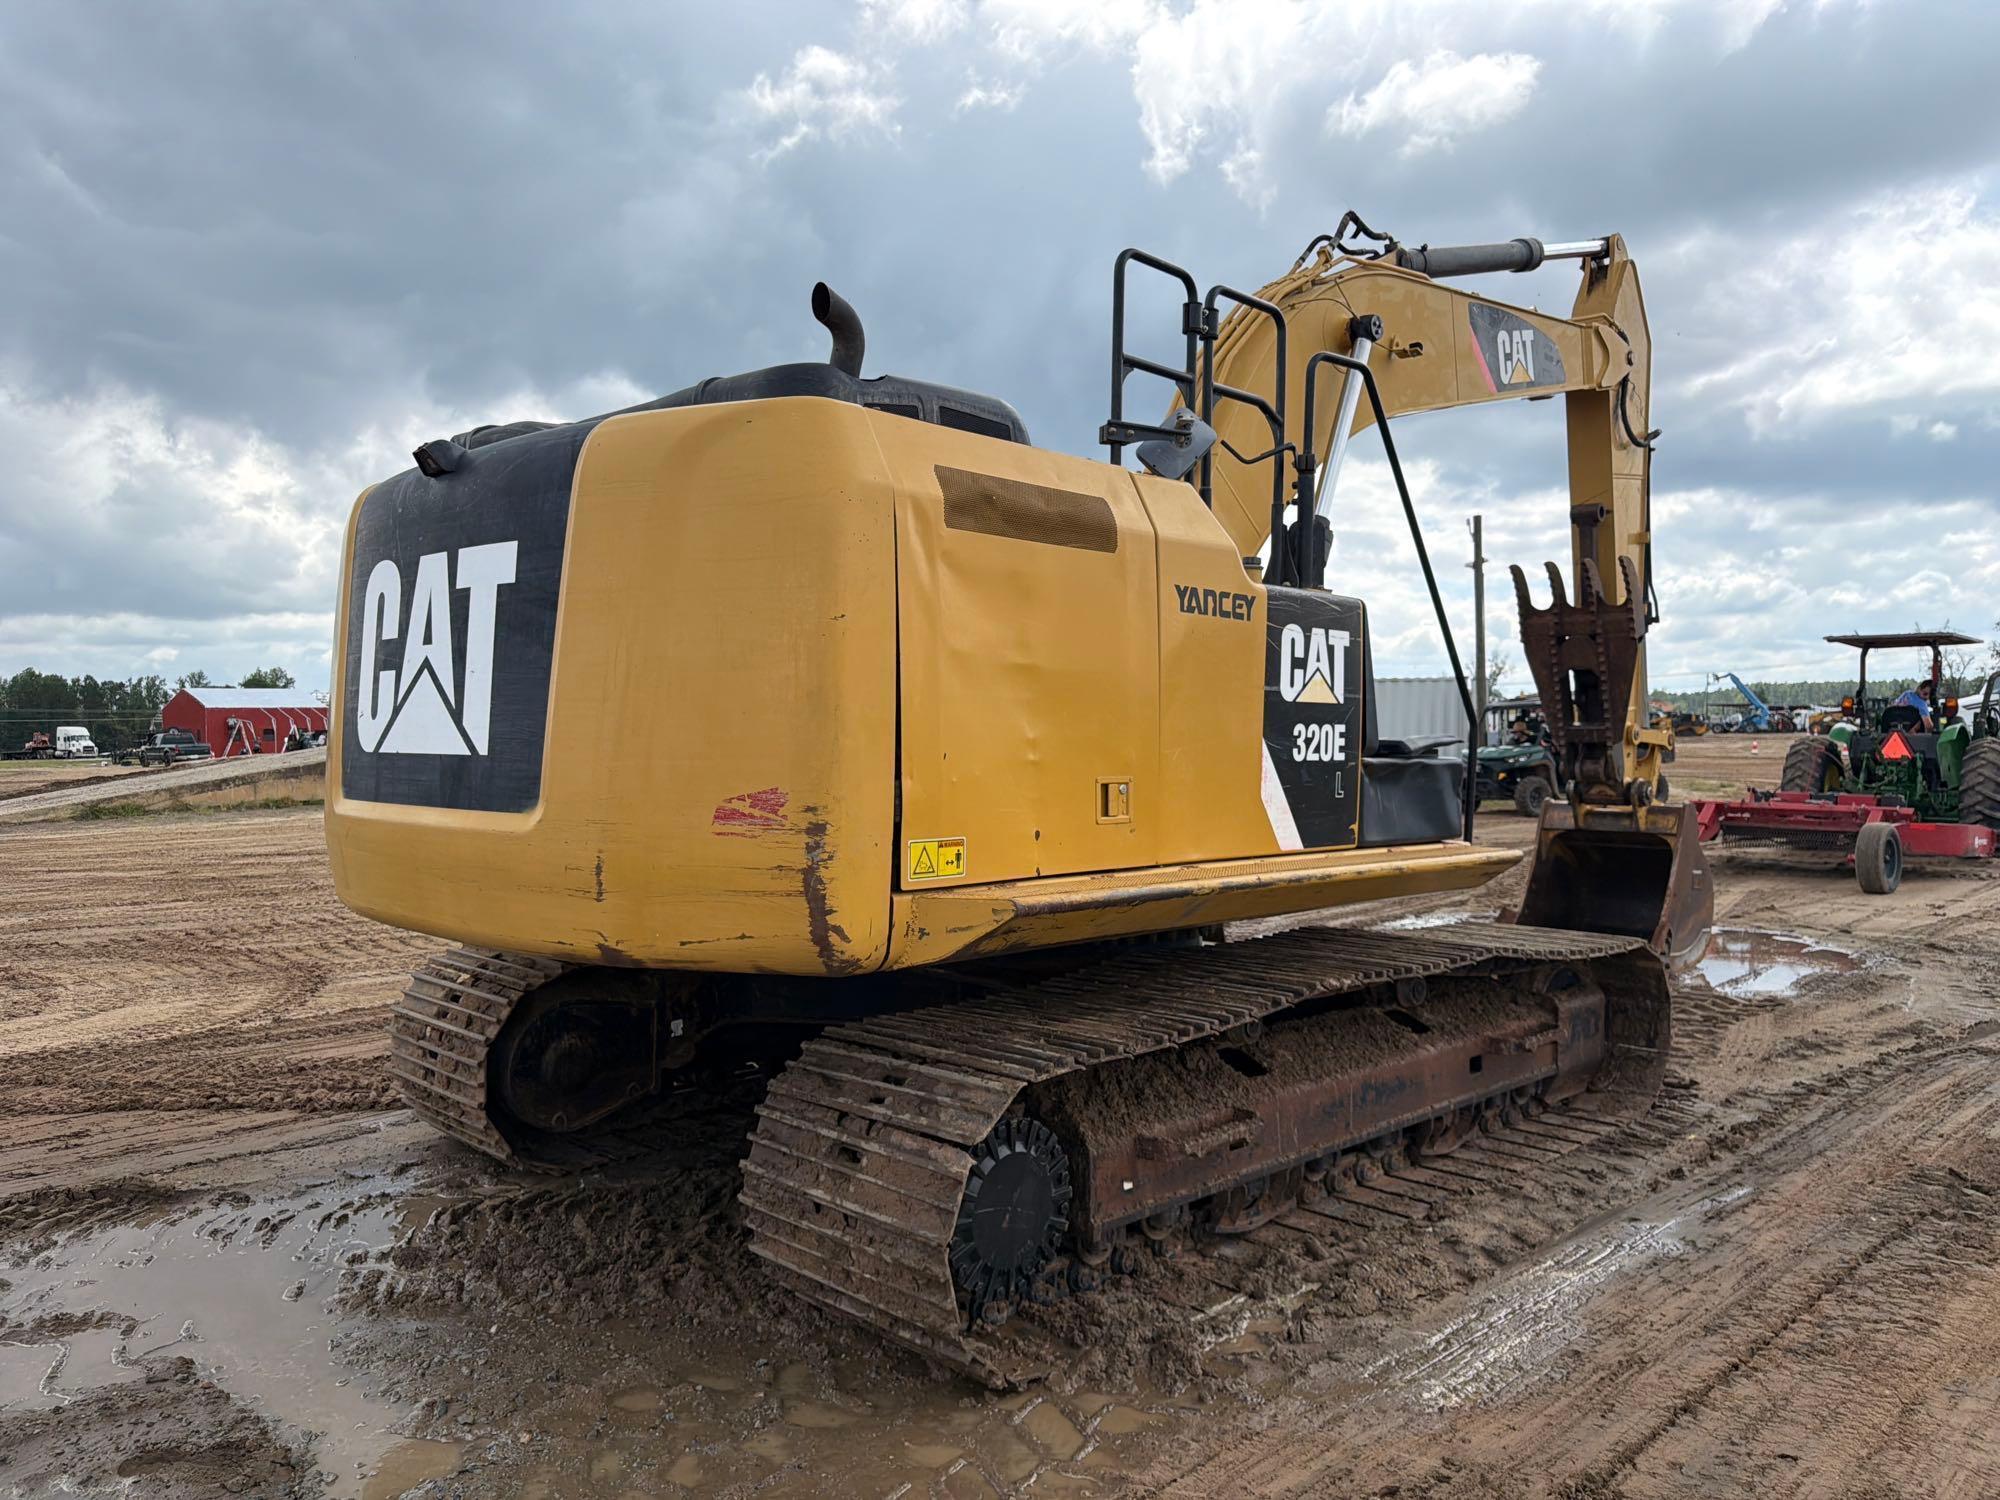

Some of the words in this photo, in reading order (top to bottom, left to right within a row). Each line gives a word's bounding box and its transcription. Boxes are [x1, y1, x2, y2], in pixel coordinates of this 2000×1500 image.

[1497, 330, 1534, 384] CAT
[1174, 584, 1256, 621] YANCEY
[358, 540, 518, 755] CAT
[1280, 623, 1350, 704] CAT
[1292, 723, 1345, 762] 320E
[1335, 772, 1344, 798] L
